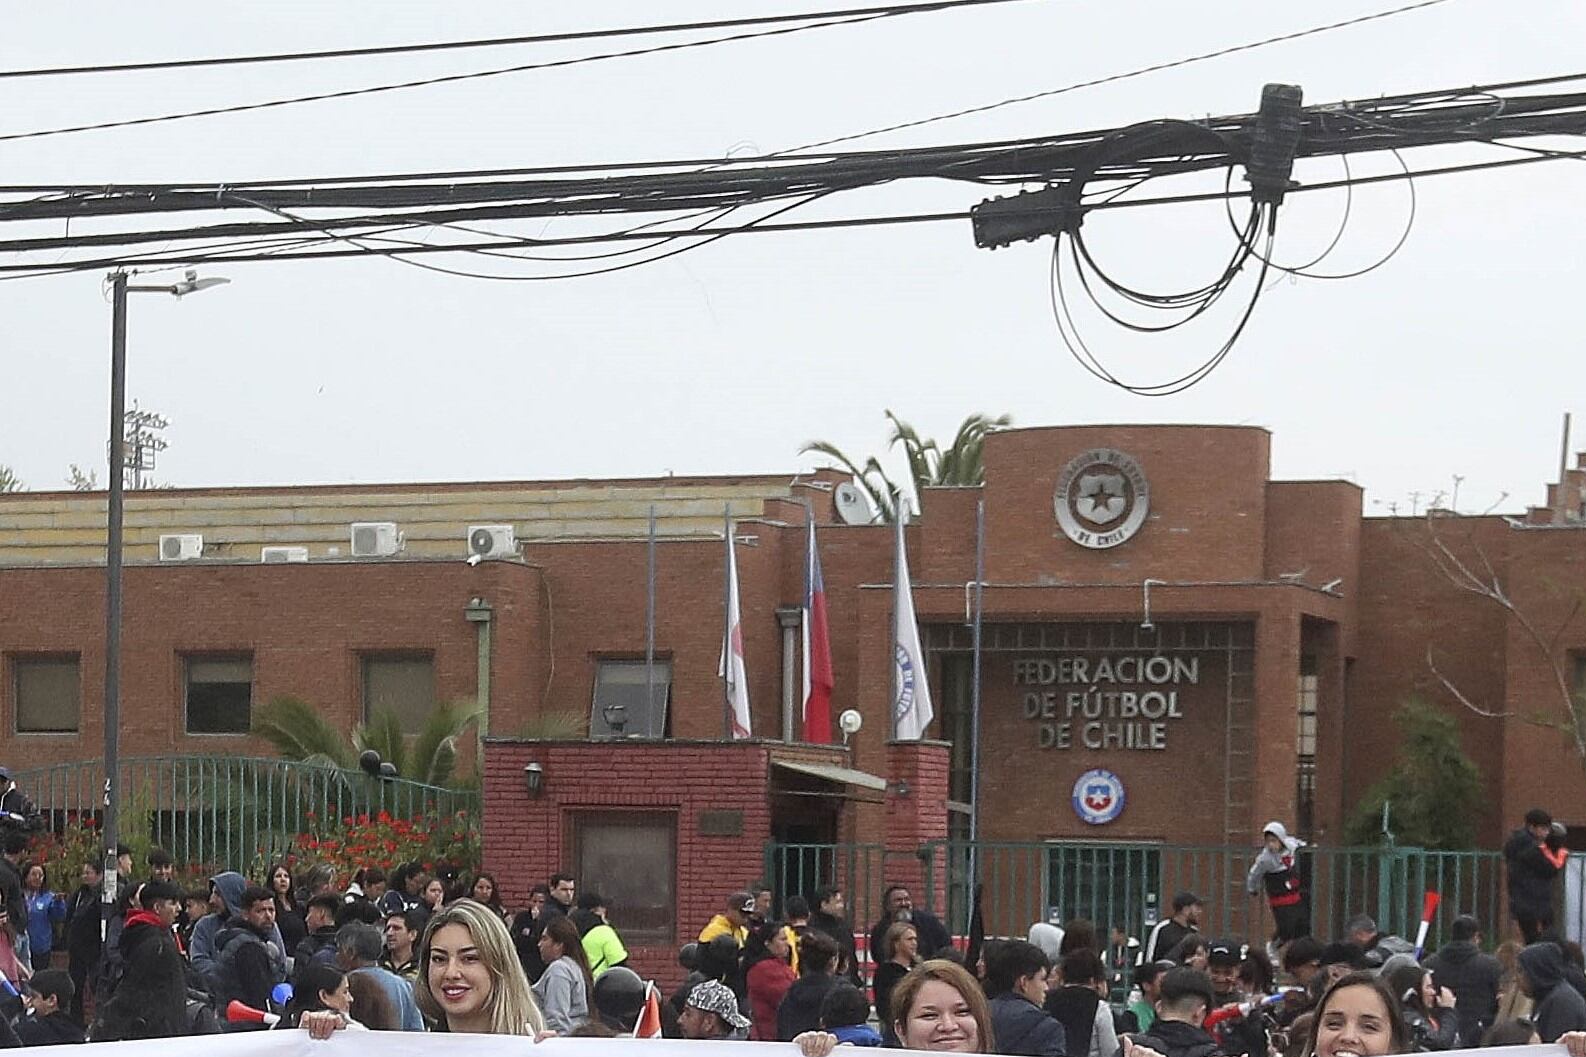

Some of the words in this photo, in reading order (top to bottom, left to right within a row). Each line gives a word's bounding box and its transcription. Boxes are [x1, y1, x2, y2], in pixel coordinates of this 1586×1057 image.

[1025, 692, 1056, 718] DE
[1066, 686, 1183, 718] FÚTBOL
[1040, 723, 1071, 748] DE
[1083, 721, 1167, 749] CHILE
